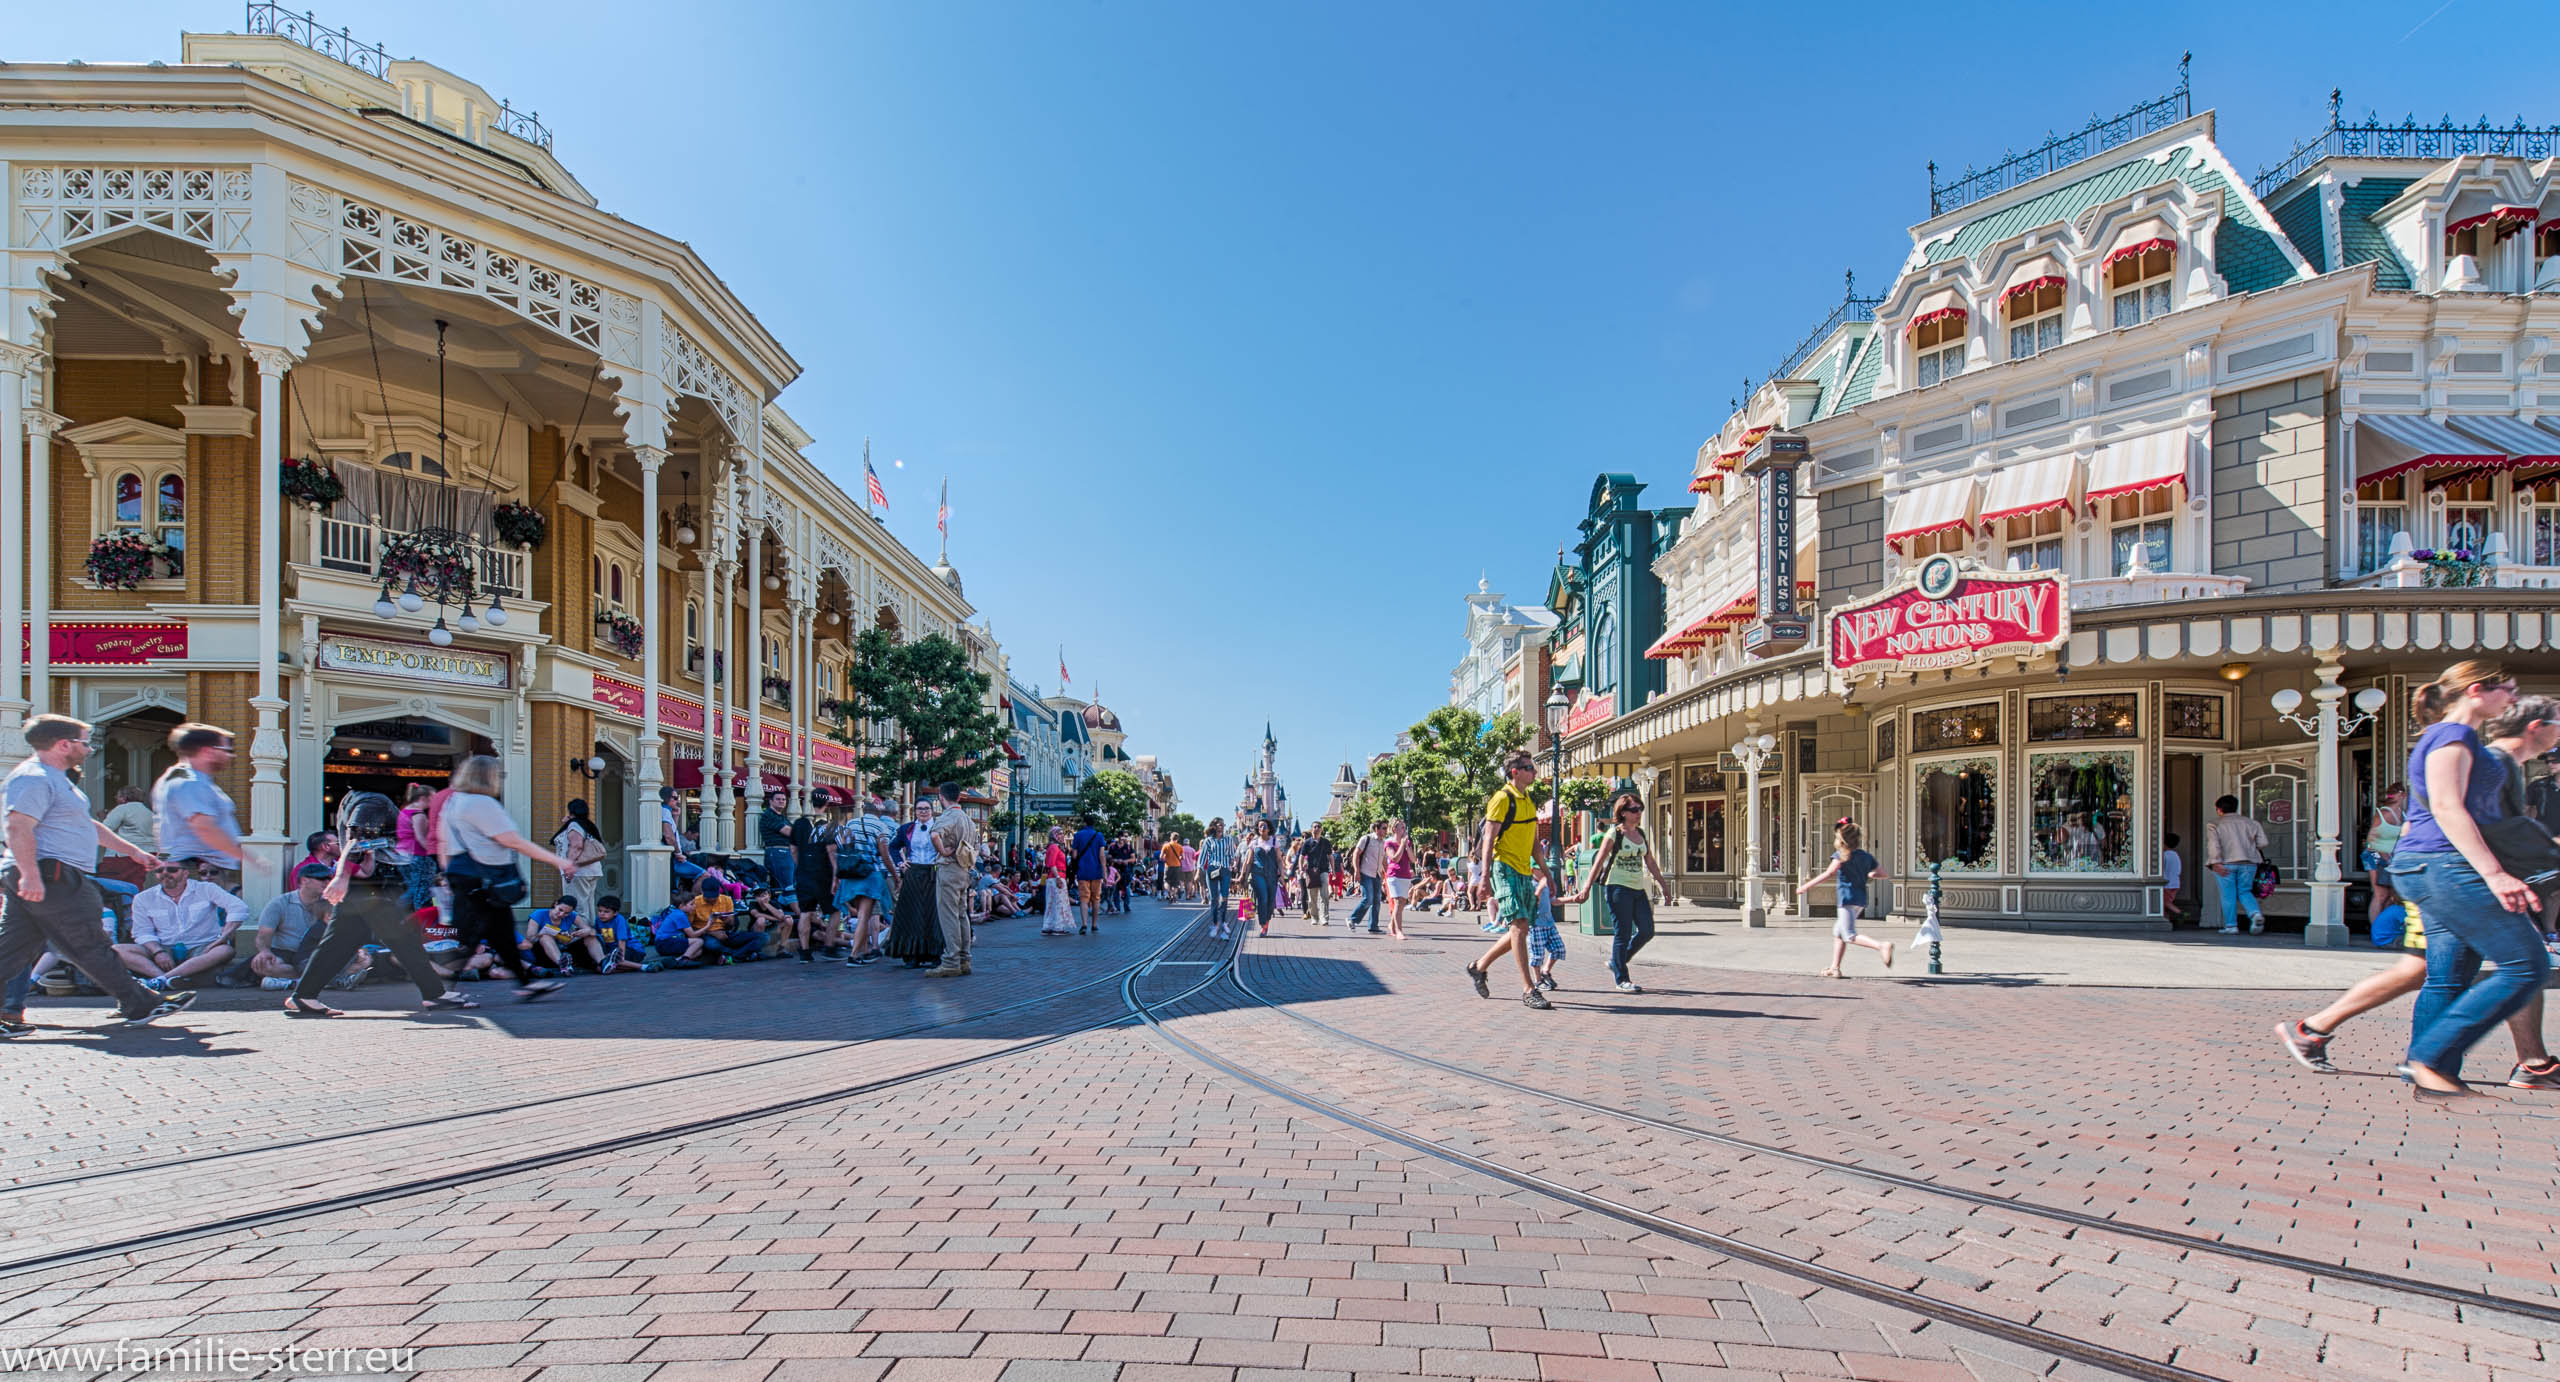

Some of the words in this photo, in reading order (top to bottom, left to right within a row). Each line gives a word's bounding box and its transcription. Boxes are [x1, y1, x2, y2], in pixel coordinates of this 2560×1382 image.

[1776, 483, 1789, 600] SOUVENIRS
[1838, 607, 1902, 662] NEW
[1905, 583, 2051, 637] CENTURY
[96, 639, 133, 653] Apparel
[130, 635, 163, 655] Jewelry
[157, 643, 185, 654] China
[1886, 623, 1992, 655] NOTIONS
[336, 645, 493, 677] EMPORIUM
[1854, 662, 1893, 674] Unique
[1906, 651, 1970, 669] FLORA'S
[1982, 644, 2031, 659] Boutique
